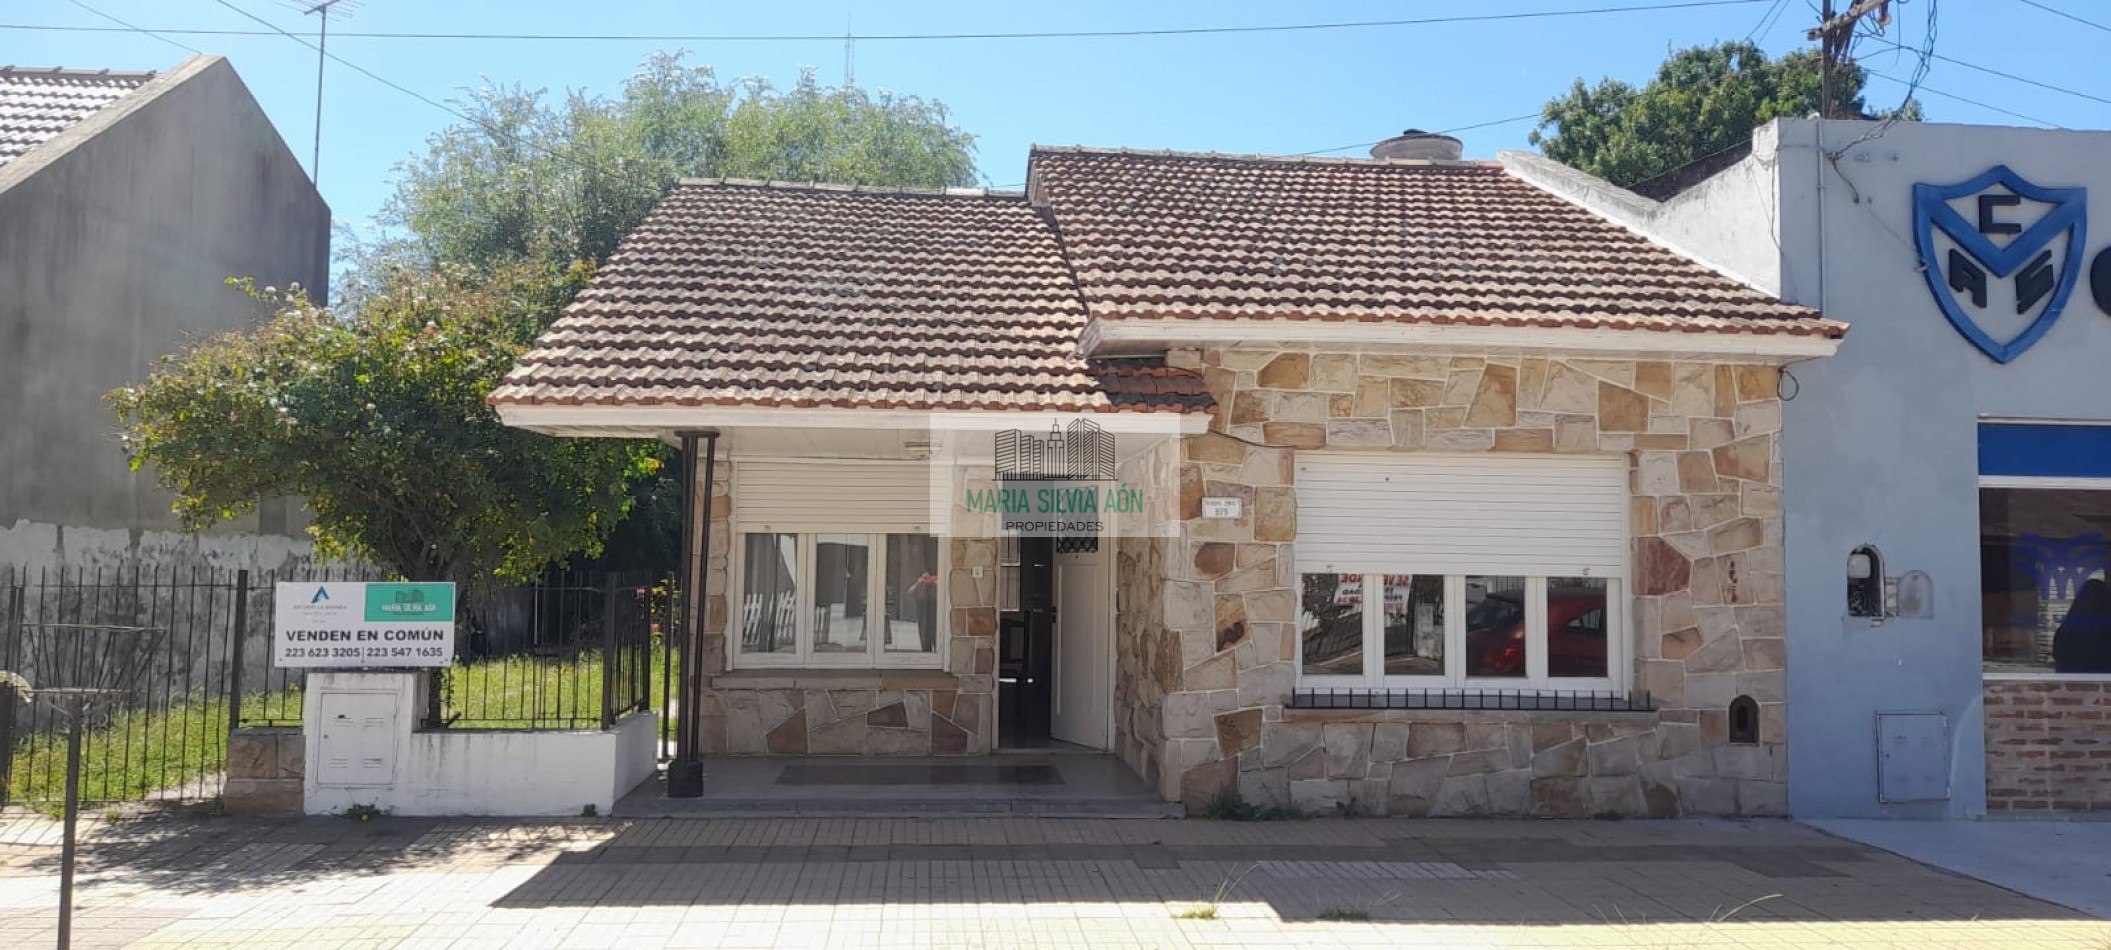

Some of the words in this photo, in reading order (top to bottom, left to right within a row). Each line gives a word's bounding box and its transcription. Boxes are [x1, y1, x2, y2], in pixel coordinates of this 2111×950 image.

[1978, 194, 2022, 234] C
[1948, 247, 1988, 309] A
[2014, 248, 2055, 315] S
[286, 630, 351, 641] VENDEN
[357, 630, 378, 641] EN
[384, 627, 444, 641] COMÚN
[285, 648, 305, 658] 223
[308, 648, 329, 658] 623
[332, 648, 361, 658] 3205
[367, 647, 388, 657] 223
[391, 647, 412, 657] 547
[417, 647, 443, 657] 1635
